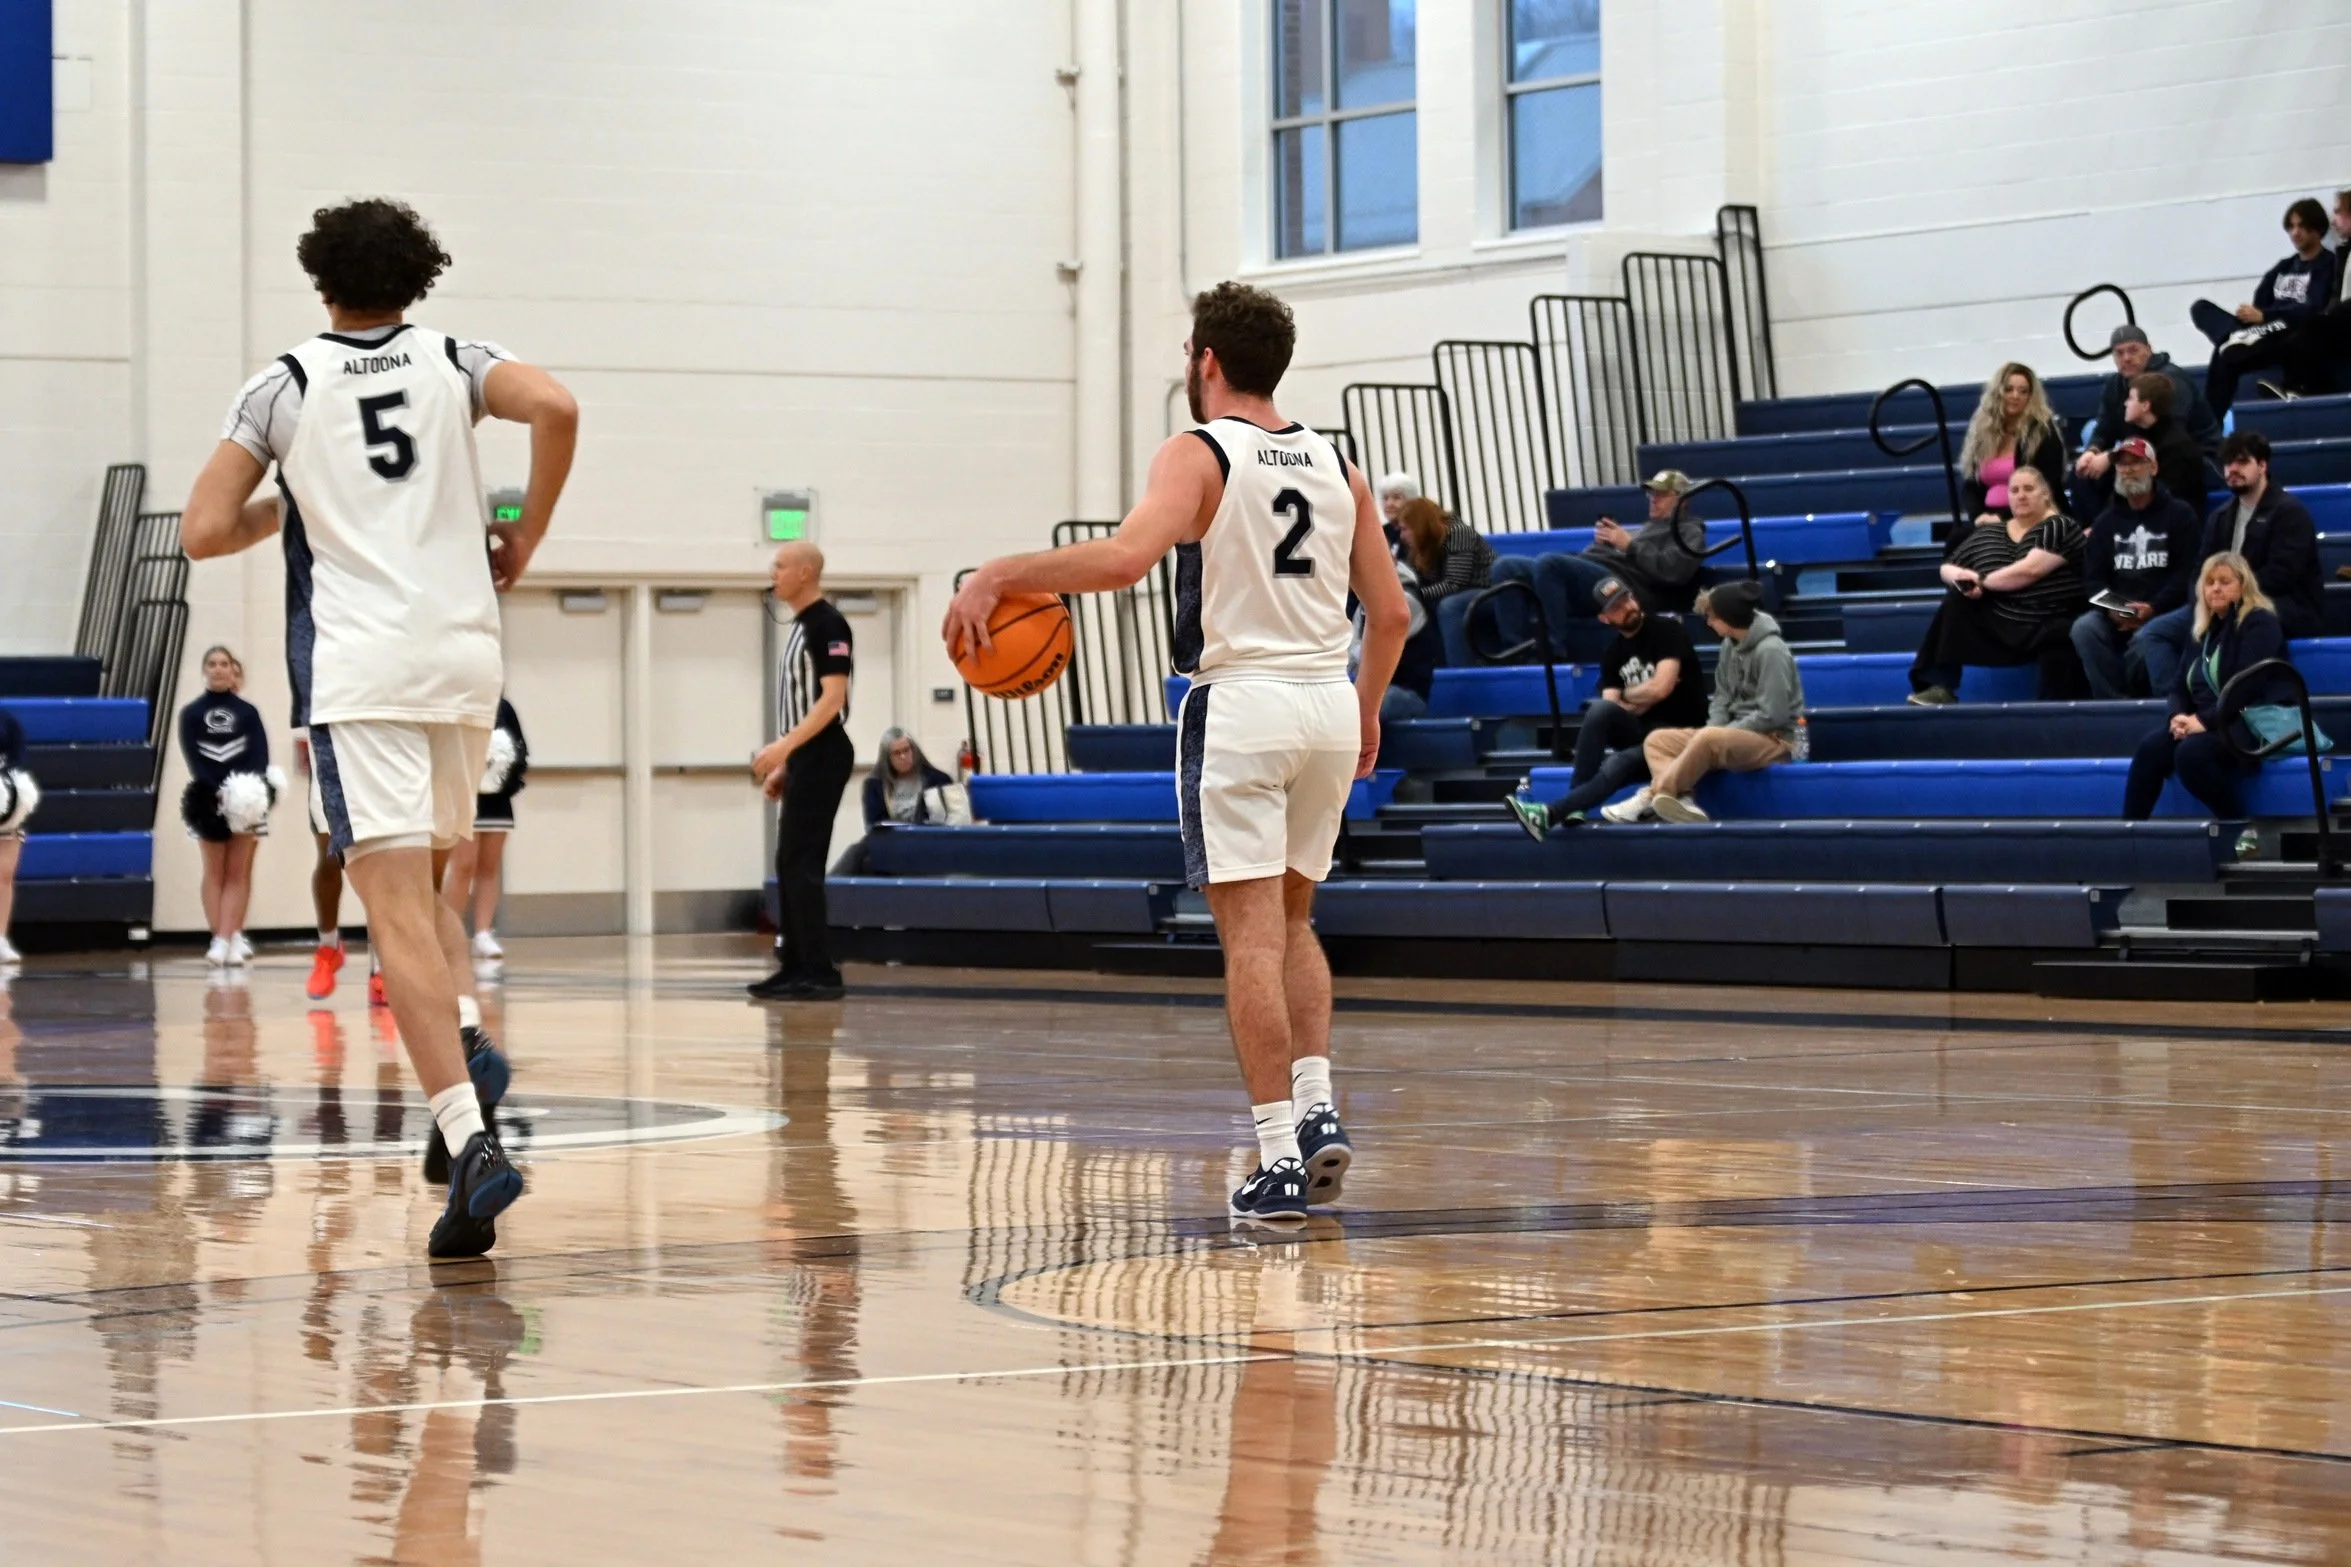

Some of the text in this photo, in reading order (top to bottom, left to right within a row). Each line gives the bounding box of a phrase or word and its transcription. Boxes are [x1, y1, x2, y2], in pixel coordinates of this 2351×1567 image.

[343, 352, 412, 375] ALTOONA
[356, 388, 421, 484] 5
[1257, 449, 1313, 468] ALTOONA
[1271, 487, 1316, 579] 2
[2136, 551, 2168, 569] ARE
